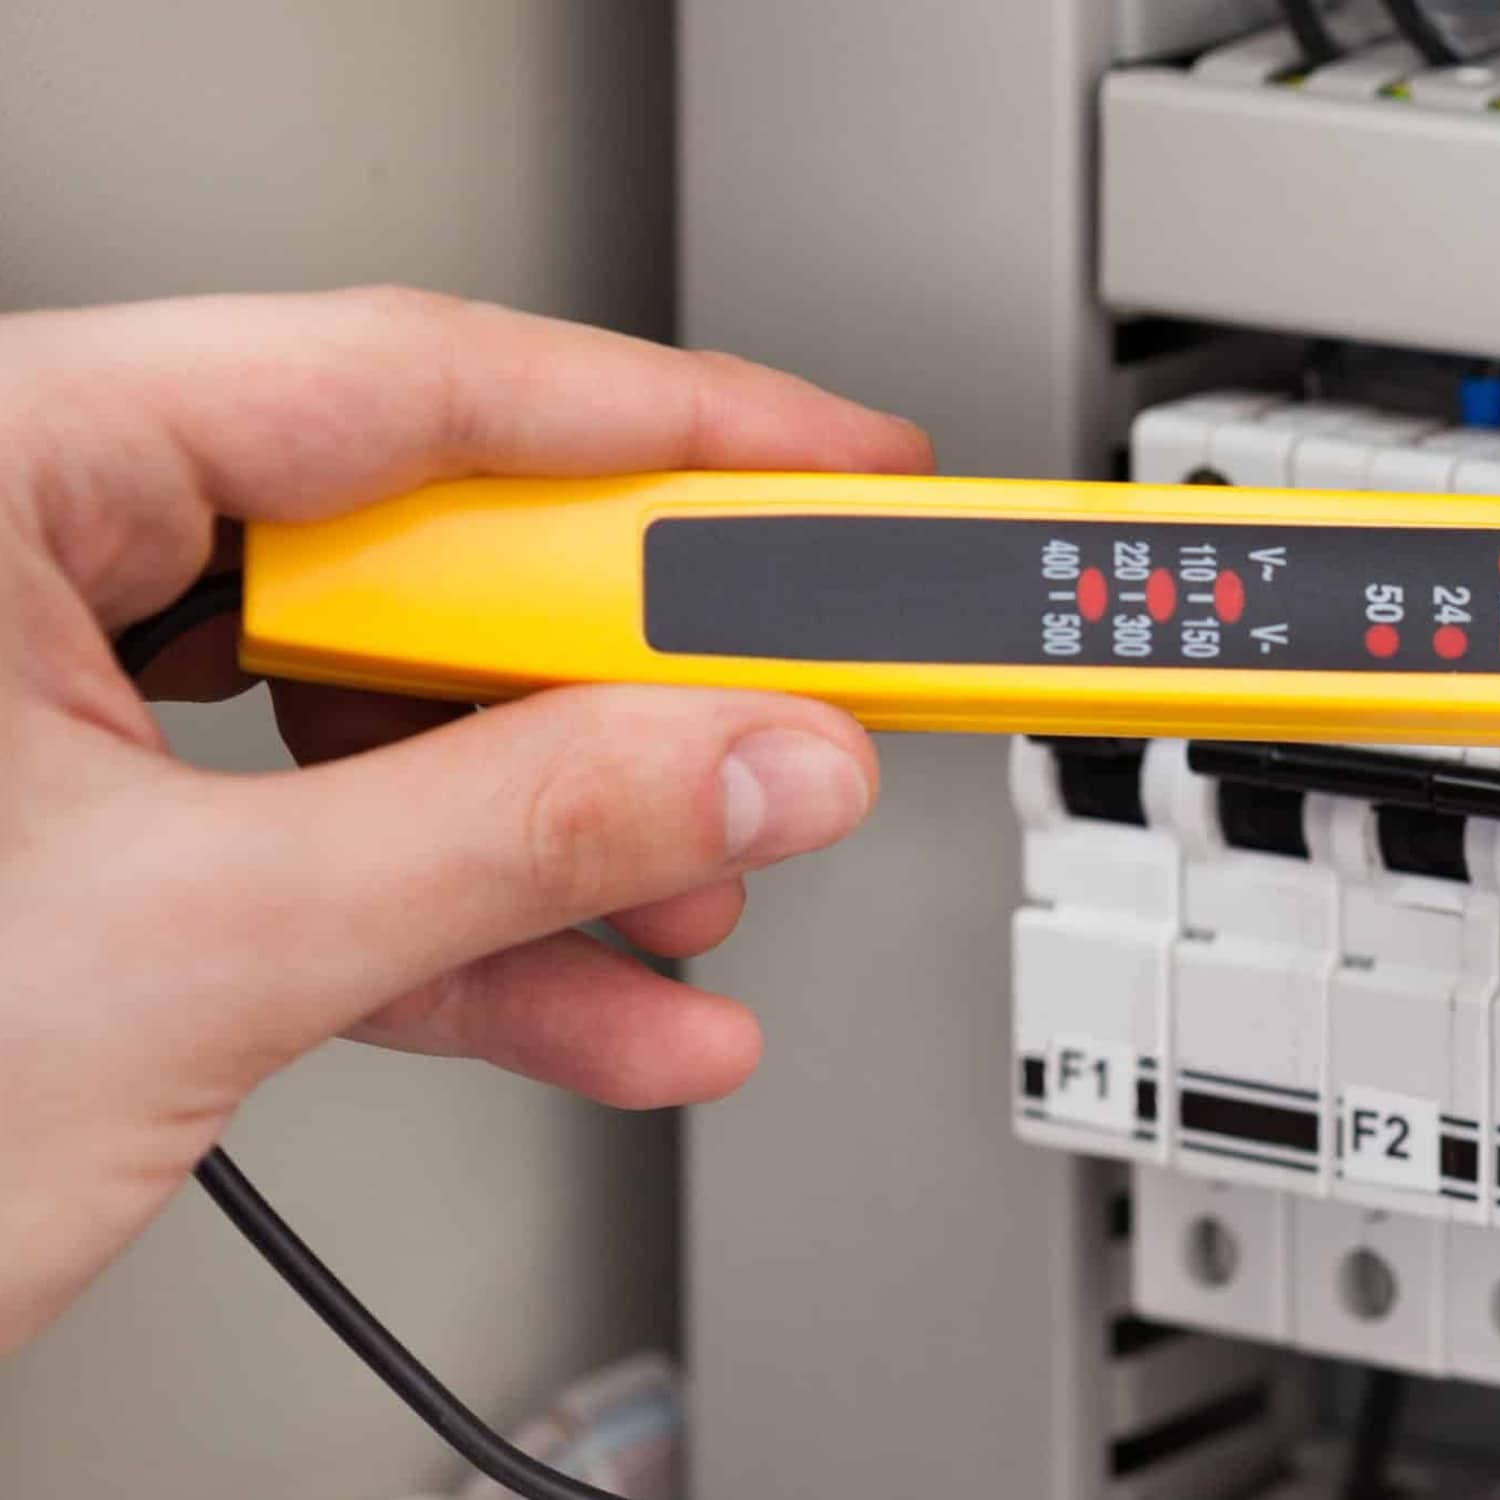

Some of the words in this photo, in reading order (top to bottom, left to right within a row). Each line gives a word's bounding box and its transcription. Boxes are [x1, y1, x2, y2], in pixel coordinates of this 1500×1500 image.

[1041, 539, 1080, 580] 400
[1113, 541, 1150, 581] 220
[1179, 543, 1217, 582] 110
[1364, 584, 1404, 623] 50
[1433, 585, 1472, 623] 24
[1042, 613, 1081, 655] 500
[1113, 614, 1152, 656] 300
[1181, 616, 1220, 658] 150
[1058, 1050, 1109, 1098] F1
[1351, 1110, 1410, 1158] F2
